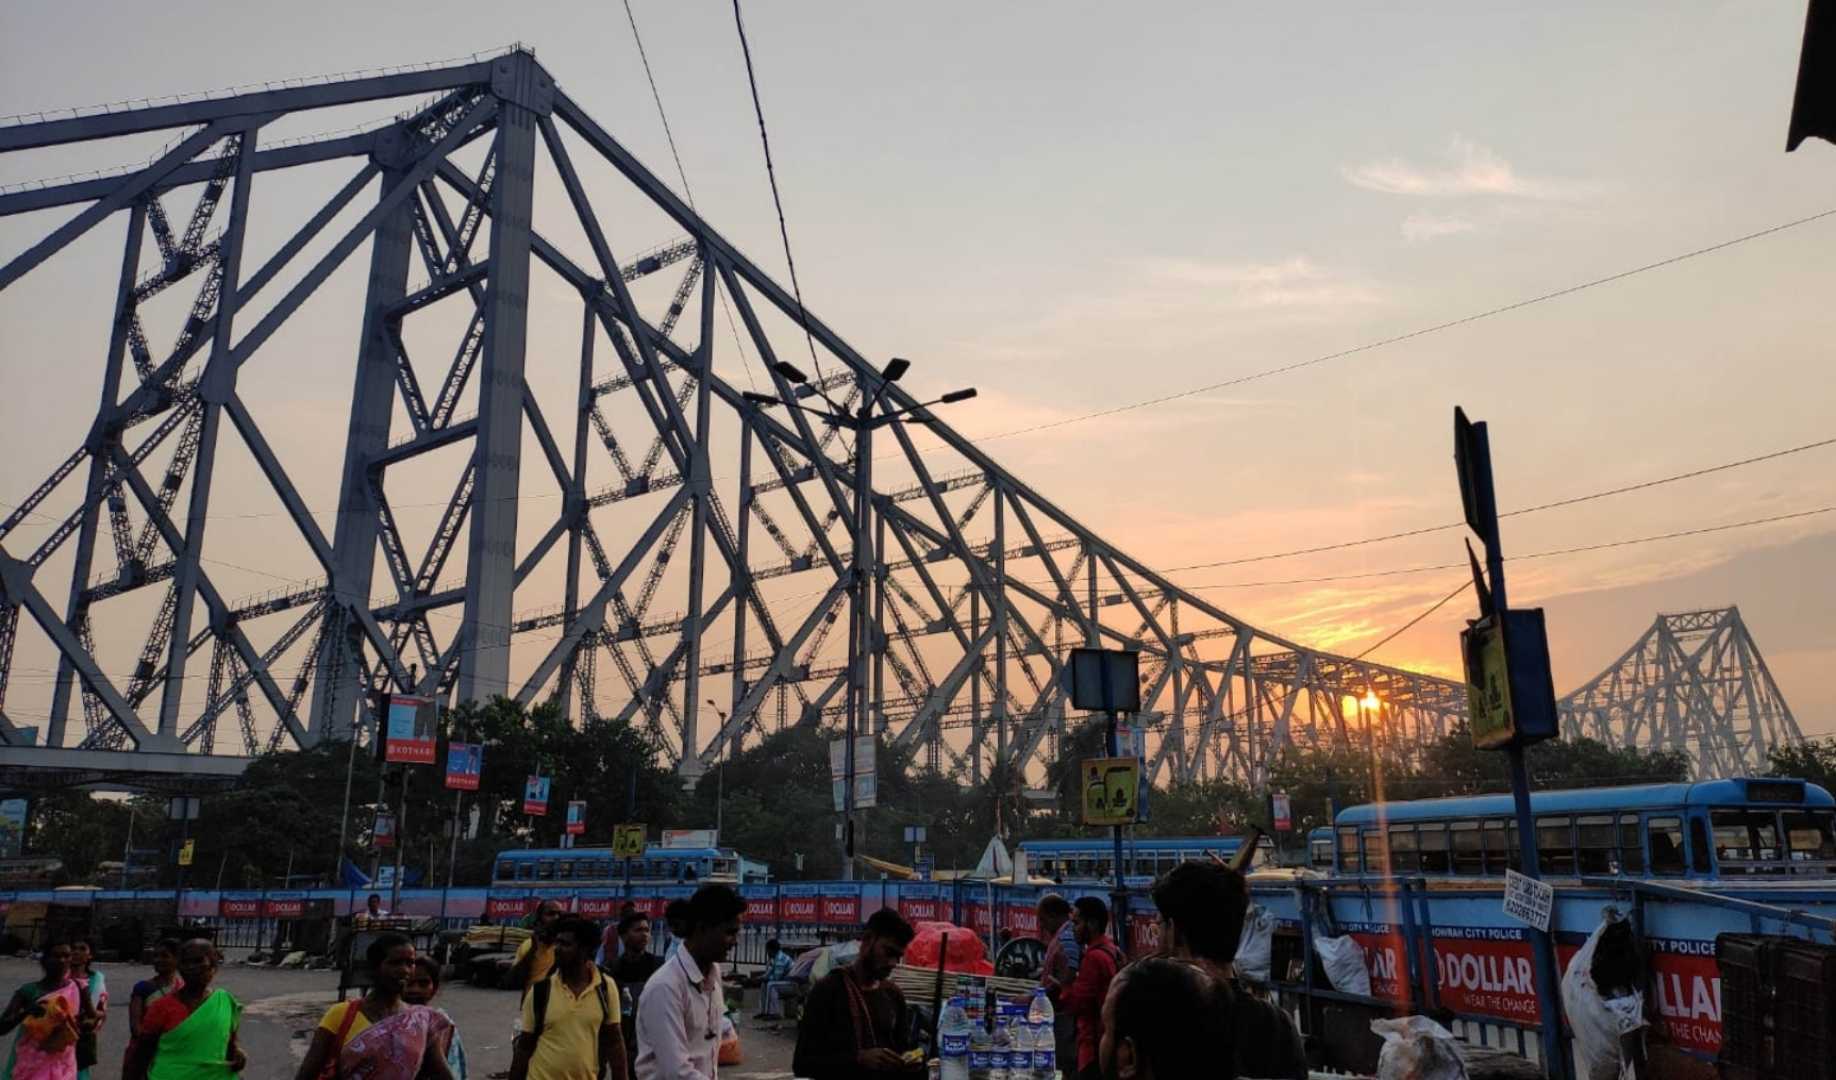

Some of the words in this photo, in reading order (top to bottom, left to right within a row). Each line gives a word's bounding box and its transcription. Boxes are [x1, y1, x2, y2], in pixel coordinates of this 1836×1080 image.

[909, 904, 935, 917] DOLLAR
[1014, 911, 1037, 930] DOLLAR
[1465, 927, 1487, 939] CITY
[1488, 928, 1522, 940] POLICE
[1670, 940, 1717, 956] POLICE
[1446, 951, 1536, 996] DOLLAR
[1655, 970, 1722, 1023] LLA
